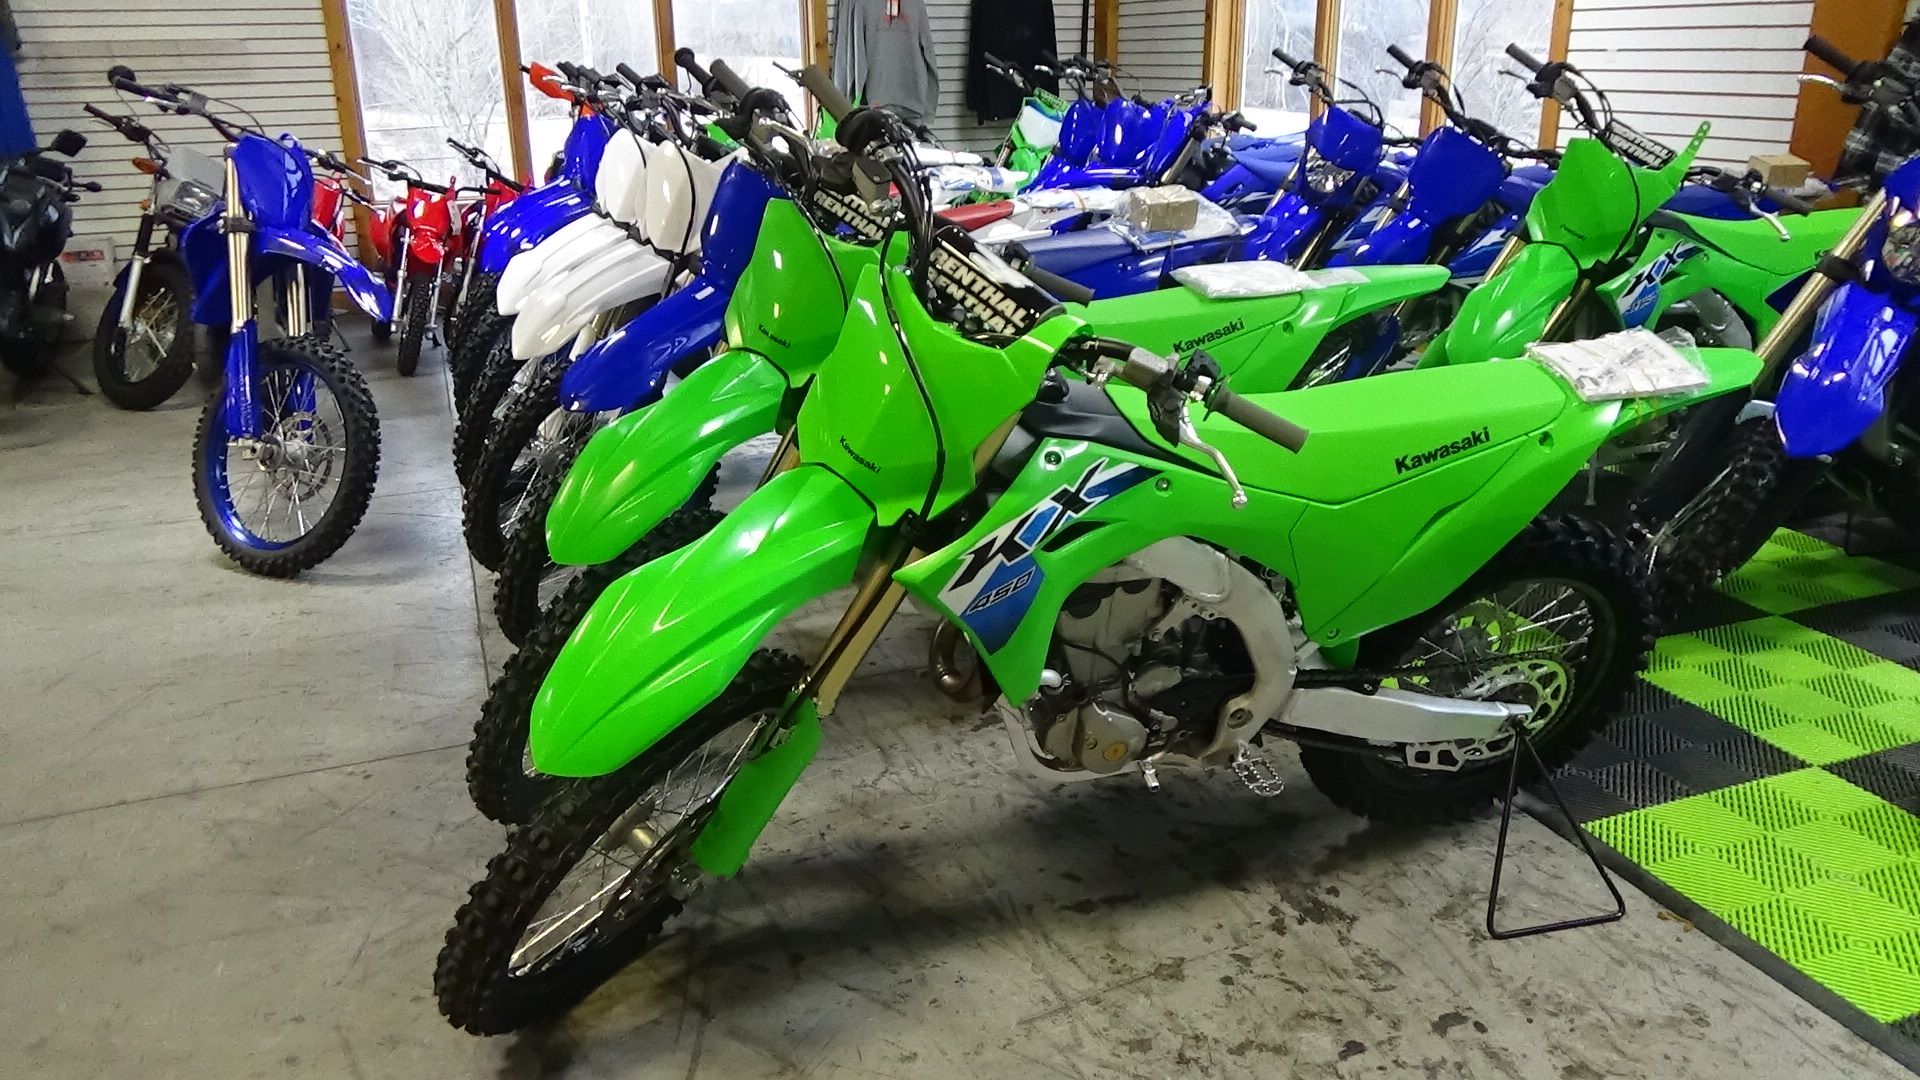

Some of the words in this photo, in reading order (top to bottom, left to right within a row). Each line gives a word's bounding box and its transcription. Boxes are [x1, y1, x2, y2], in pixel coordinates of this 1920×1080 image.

[929, 247, 1028, 329] RENTHAL
[1172, 316, 1245, 354] Kawasaki
[839, 435, 882, 475] Kawasaki
[1394, 426, 1491, 475] Kawasaki
[965, 565, 1037, 616] 450
